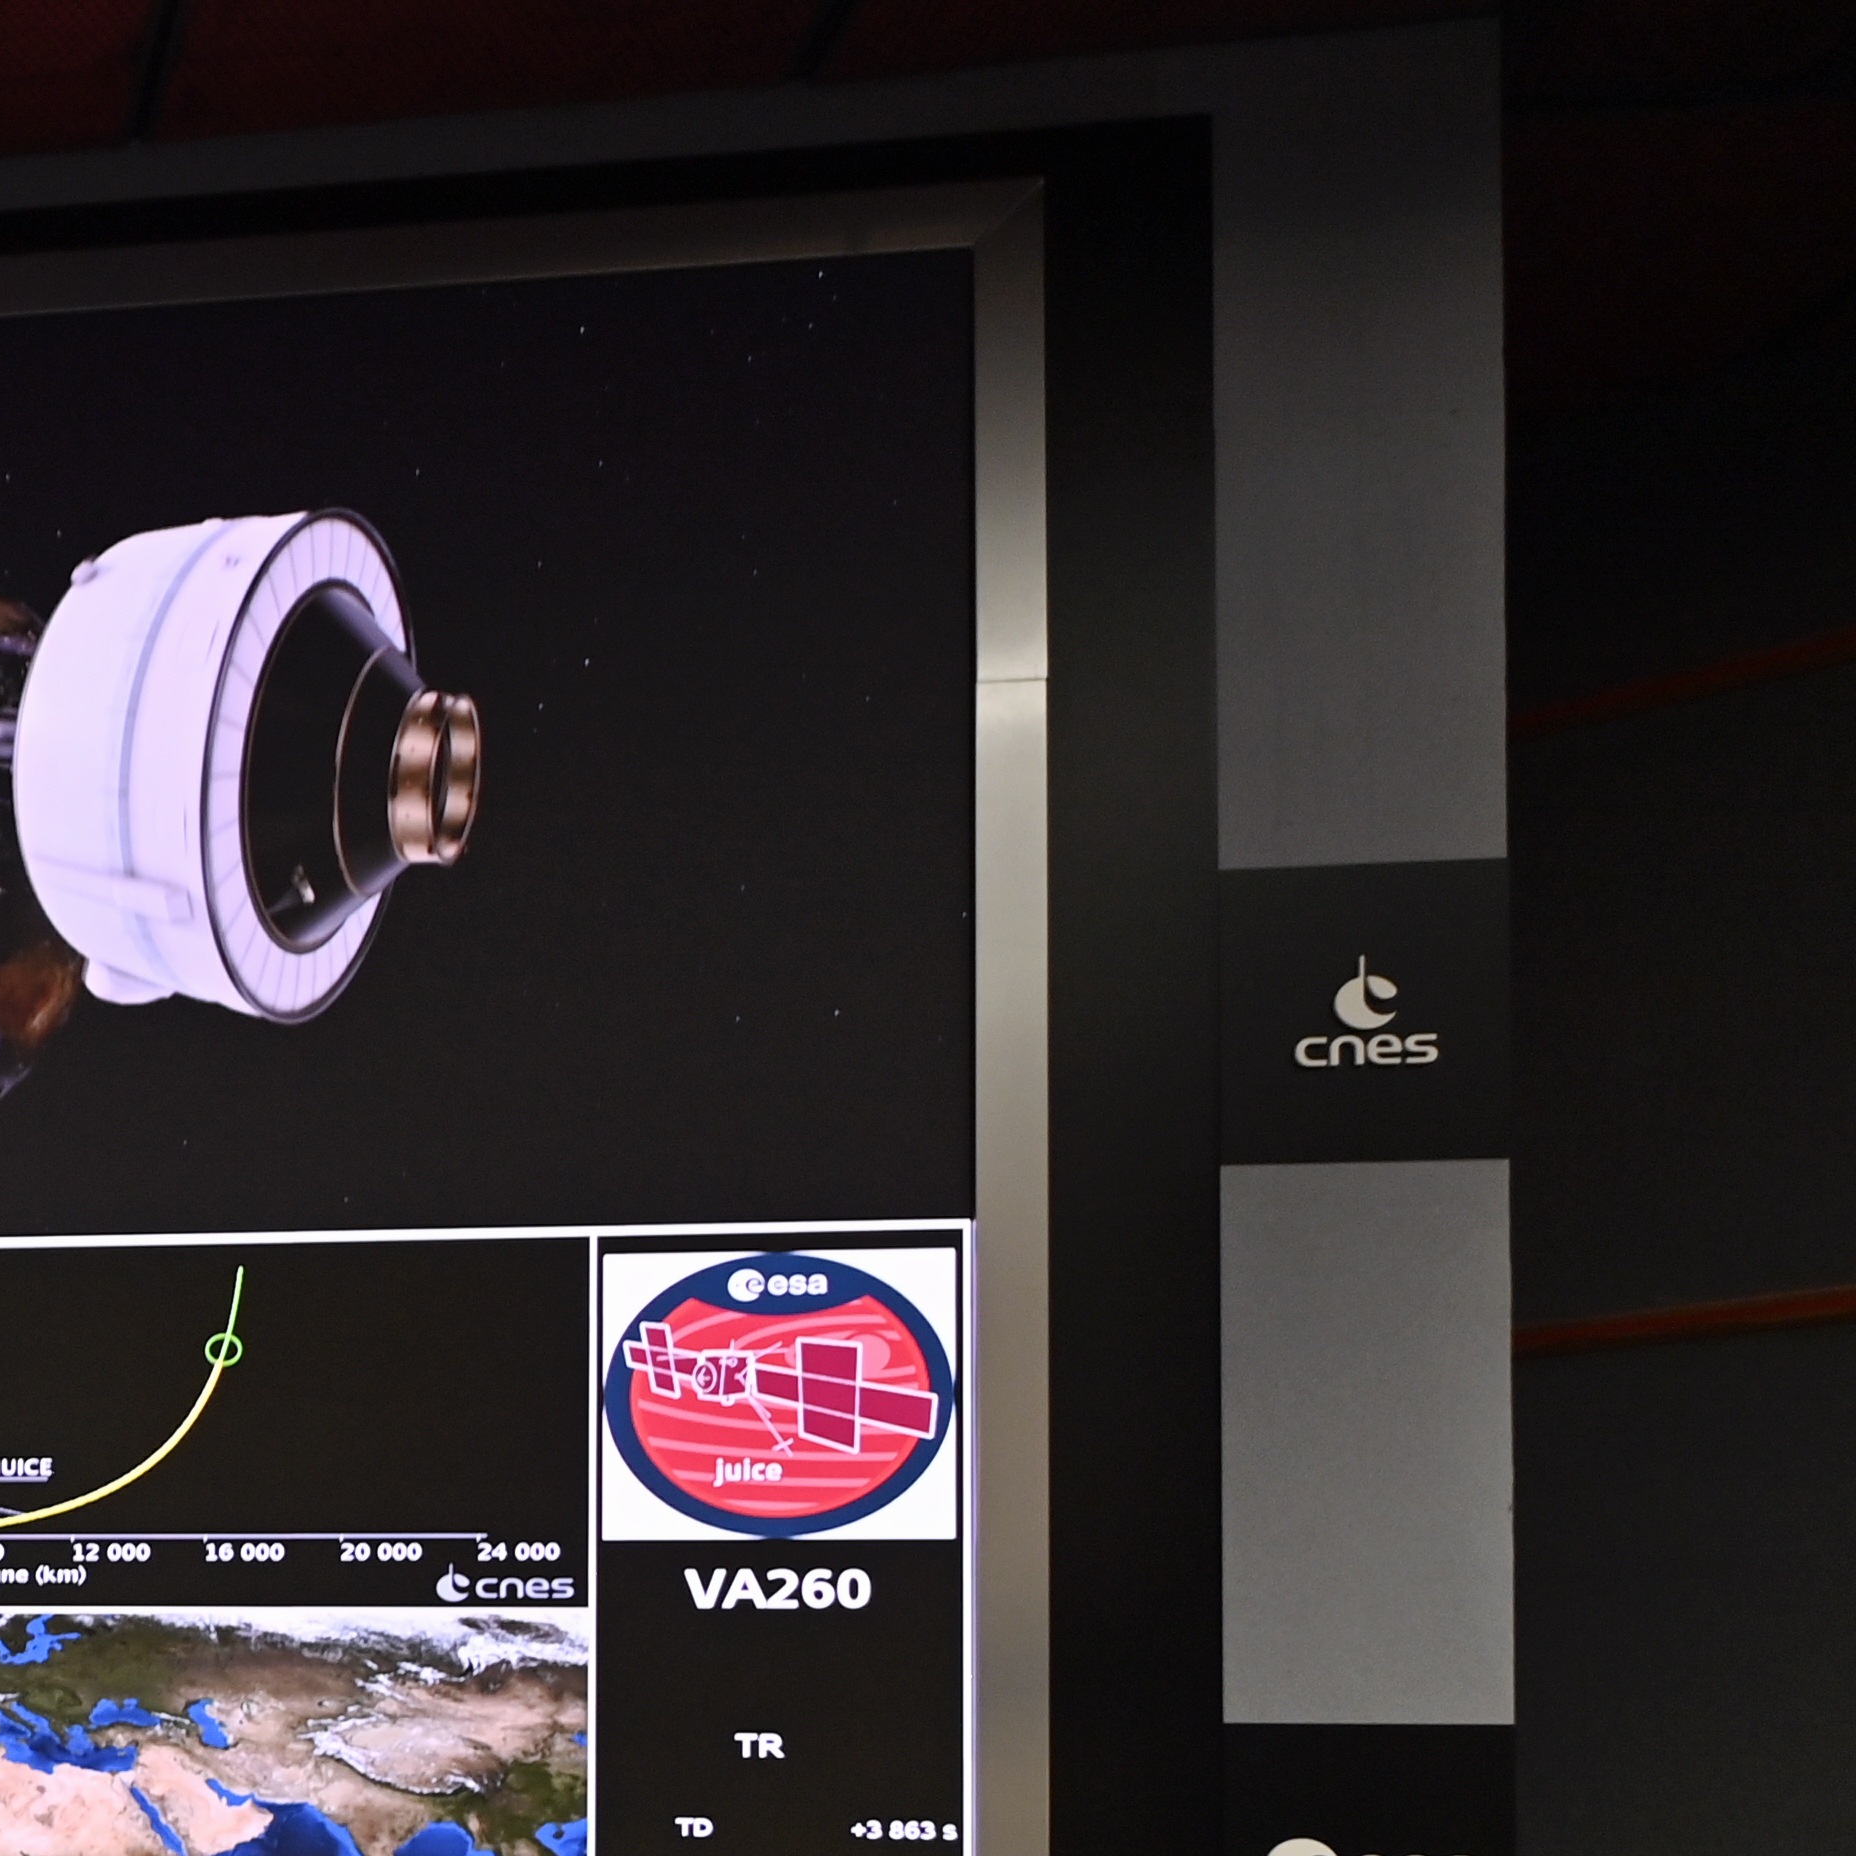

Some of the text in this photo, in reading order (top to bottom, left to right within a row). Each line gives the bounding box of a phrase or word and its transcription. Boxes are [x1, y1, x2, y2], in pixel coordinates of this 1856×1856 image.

[1295, 1032, 1439, 1067] cnes
[714, 1458, 782, 1487] juice
[72, 1543, 151, 1561] 12 000
[205, 1543, 285, 1561] 16 000
[341, 1543, 423, 1561] 20 000
[478, 1543, 562, 1561] 24 000
[36, 1564, 87, 1585] (km)
[476, 1575, 576, 1600] cnes
[685, 1569, 872, 1610] VA260
[735, 1733, 785, 1758] TR
[675, 1817, 714, 1837] TD
[889, 1820, 936, 1840] 863
[942, 1824, 957, 1840] s
